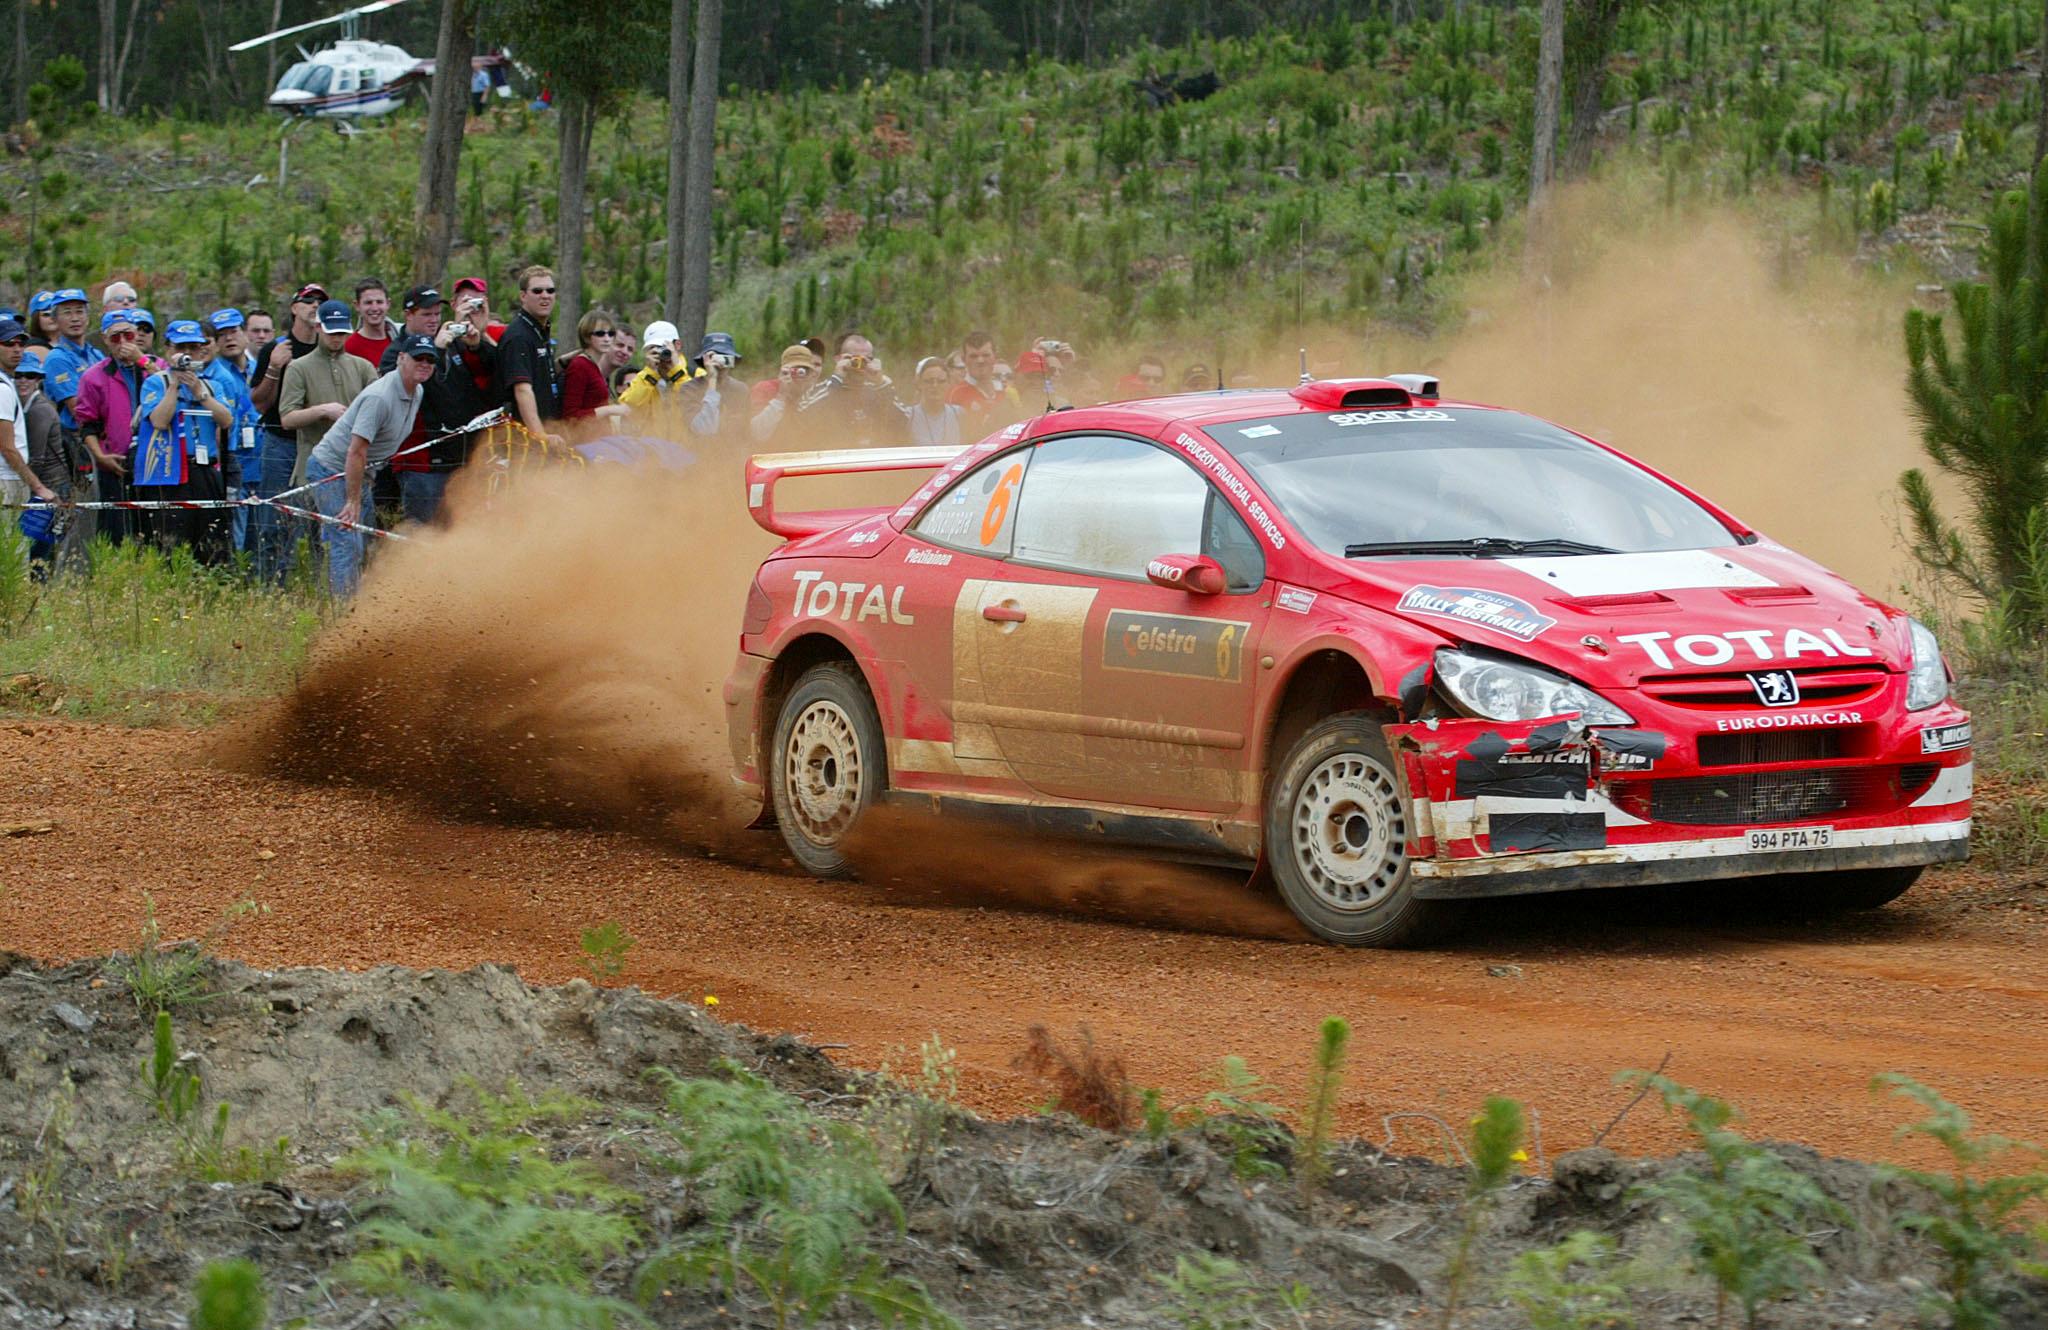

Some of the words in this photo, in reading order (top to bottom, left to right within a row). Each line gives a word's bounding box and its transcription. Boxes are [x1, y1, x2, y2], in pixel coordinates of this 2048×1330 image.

[1328, 409, 1451, 426] sparco
[980, 463, 1023, 547] 6
[1180, 438, 1218, 469] PEUGEOT
[1213, 462, 1252, 507] FINANCIAL
[1248, 501, 1286, 550] SERVICES
[1148, 560, 1183, 582] NIKKO
[793, 570, 914, 626] TOTAL
[1405, 590, 1450, 613] RALLY
[1451, 605, 1541, 637] AUSTRALIA
[1122, 624, 1197, 657] Telstra
[1216, 625, 1235, 678] 6
[1617, 628, 1872, 670] TOTAL
[1717, 711, 1863, 732] EURODATACAR
[1752, 833, 1777, 849] 994
[1782, 831, 1808, 848] PTA
[1813, 829, 1829, 846] 75
